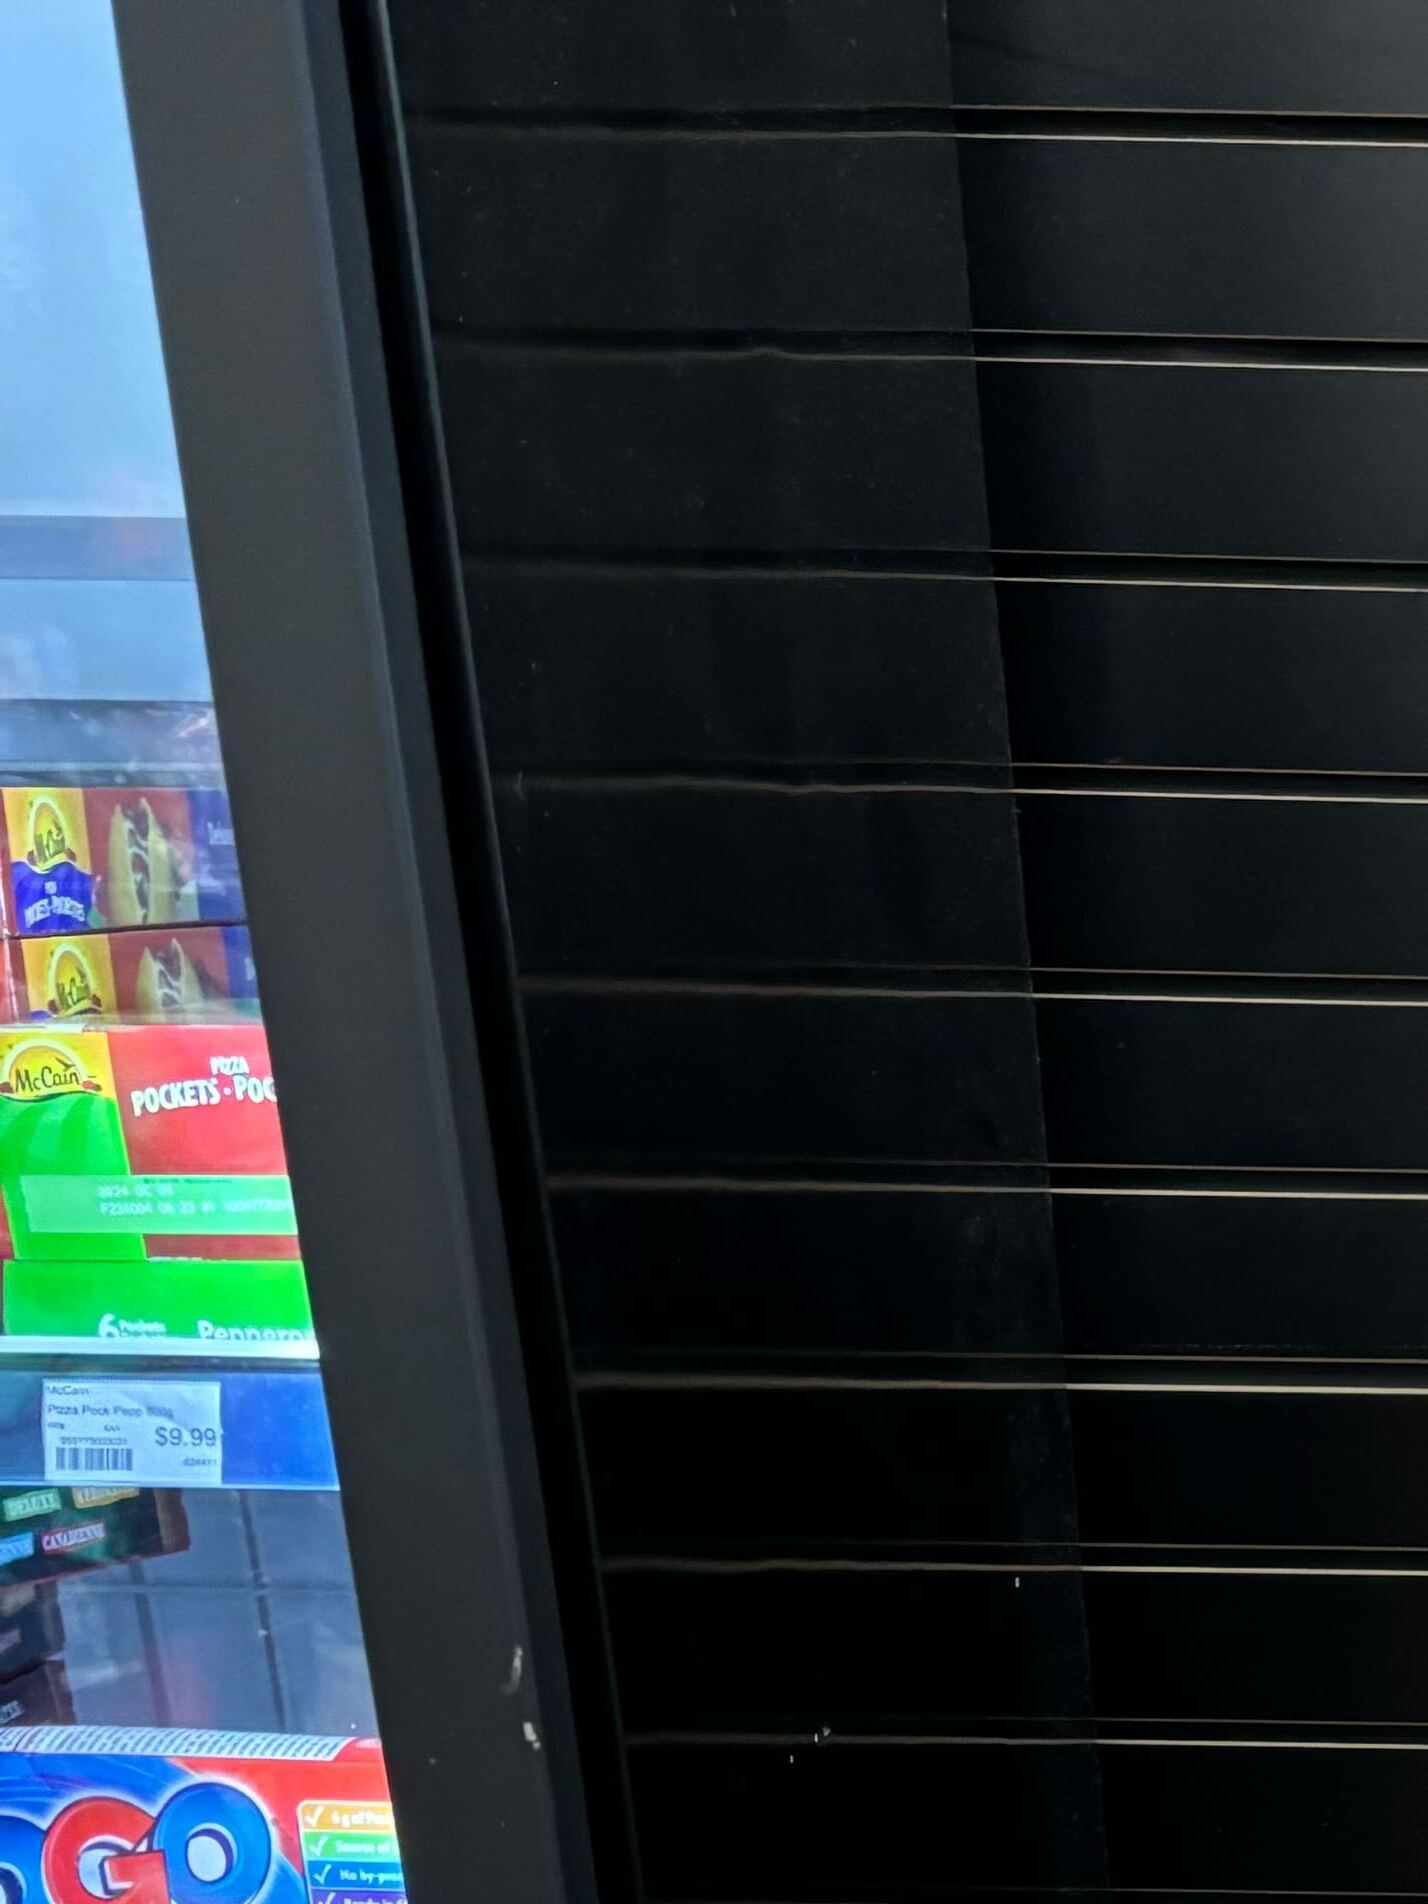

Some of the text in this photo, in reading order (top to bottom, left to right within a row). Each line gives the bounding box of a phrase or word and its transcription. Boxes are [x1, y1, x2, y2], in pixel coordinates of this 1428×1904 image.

[210, 1056, 249, 1075] PIZZA
[14, 1066, 80, 1092] McCain
[131, 1078, 221, 1116] POCKETS
[155, 1426, 216, 1448] $9.99
